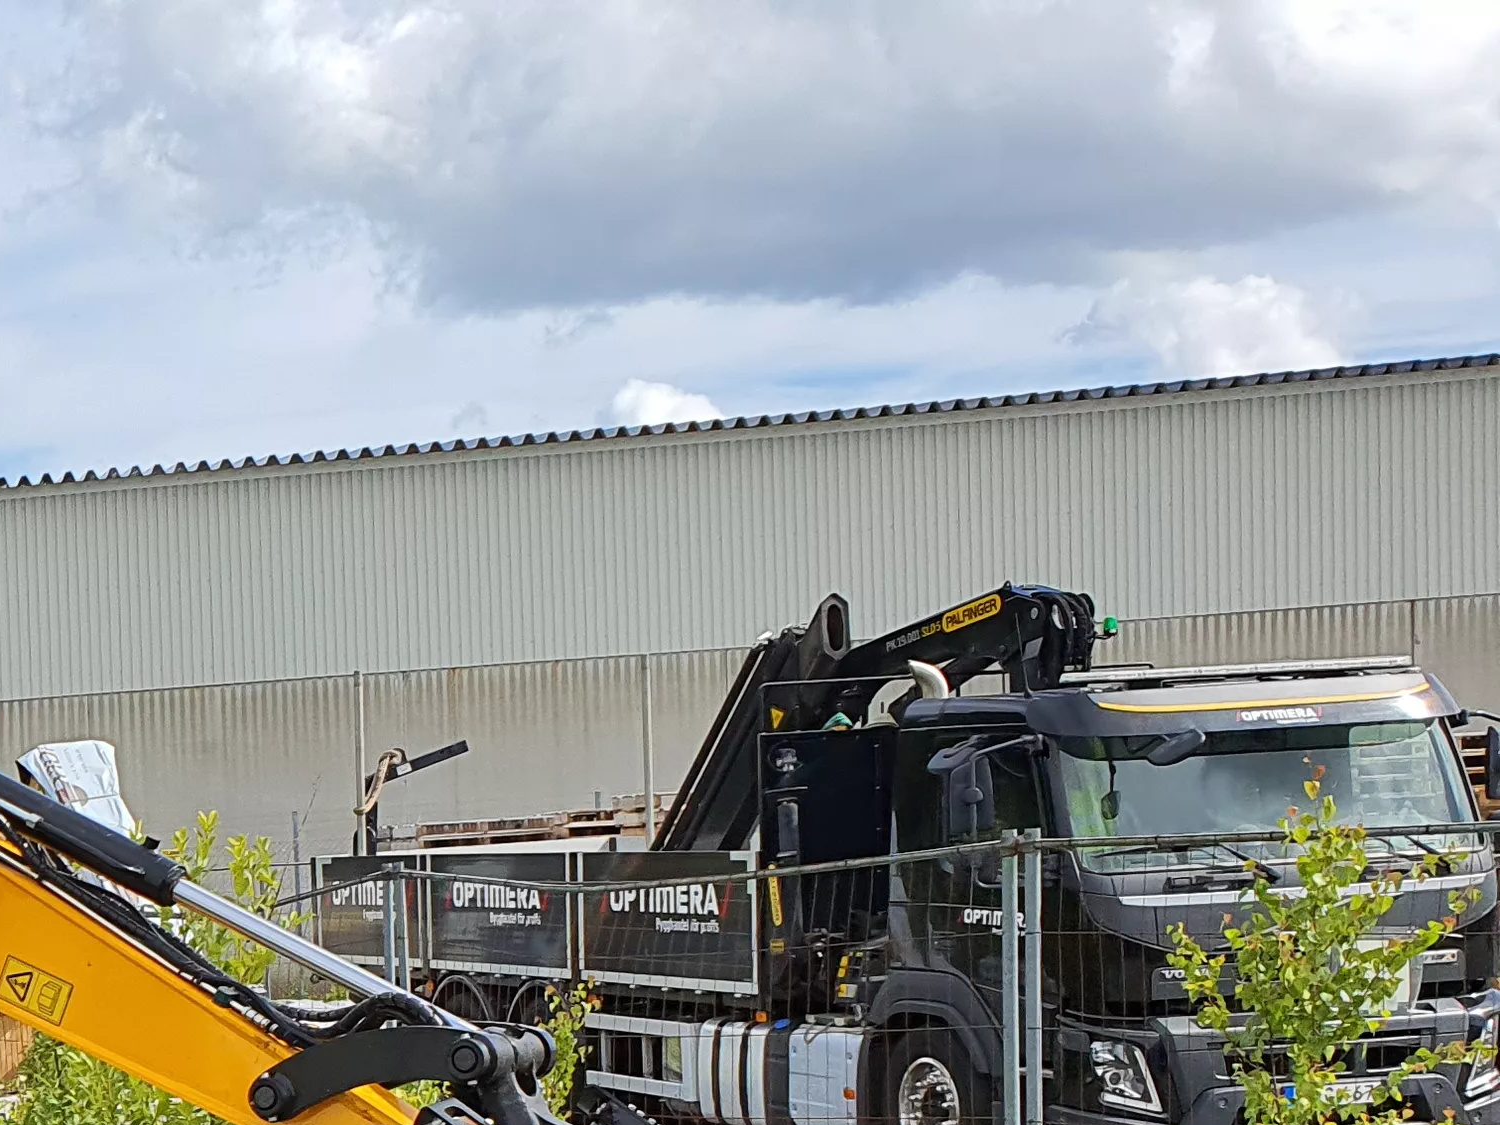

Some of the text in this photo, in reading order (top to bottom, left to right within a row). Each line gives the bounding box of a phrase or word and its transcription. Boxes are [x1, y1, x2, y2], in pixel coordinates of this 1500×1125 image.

[1240, 707, 1317, 722] OPTIMERA
[332, 880, 384, 906] OPTIME
[452, 881, 541, 910] OPTIMERA
[609, 883, 720, 916] OPTIMERA
